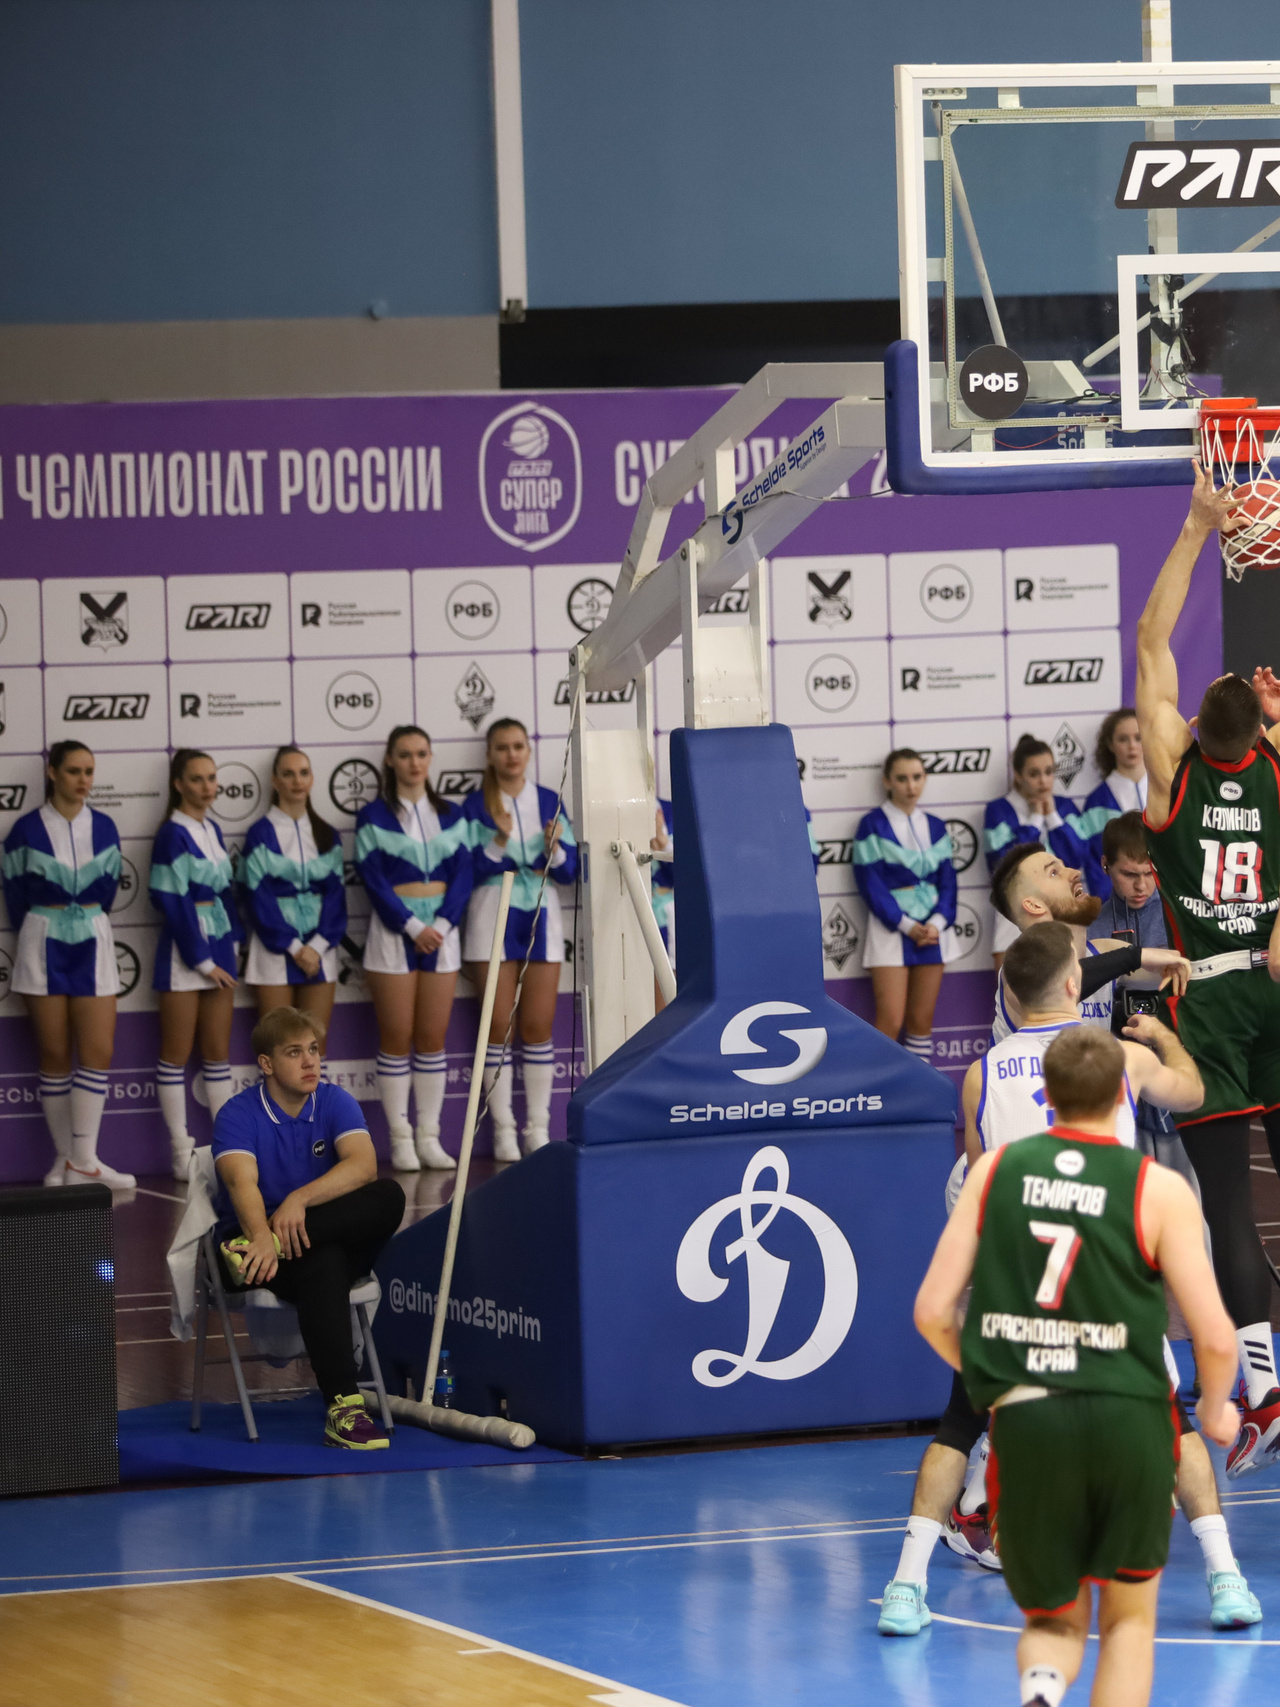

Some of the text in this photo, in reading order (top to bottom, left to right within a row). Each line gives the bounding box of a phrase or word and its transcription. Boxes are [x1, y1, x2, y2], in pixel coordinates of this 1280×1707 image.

[969, 373, 1018, 392] РФБ
[279, 447, 443, 514] РОССИИ
[742, 426, 825, 507] Schelde Sports
[927, 585, 966, 600] РФБ
[186, 603, 271, 631] PARI
[453, 602, 493, 618] РФБ
[813, 675, 851, 690] РФБ
[1024, 658, 1104, 686] PARI
[63, 694, 150, 721] PARI
[333, 693, 374, 709] РФБ
[1199, 839, 1263, 904] 18
[669, 1093, 883, 1123] Schelde Sports
[1022, 1175, 1108, 1217] ТЕМИРОВ
[1029, 1220, 1083, 1310] 7
[981, 1312, 1128, 1350] КРАСНОДАРСКИЙ
[1026, 1347, 1078, 1372] КРАЙ
